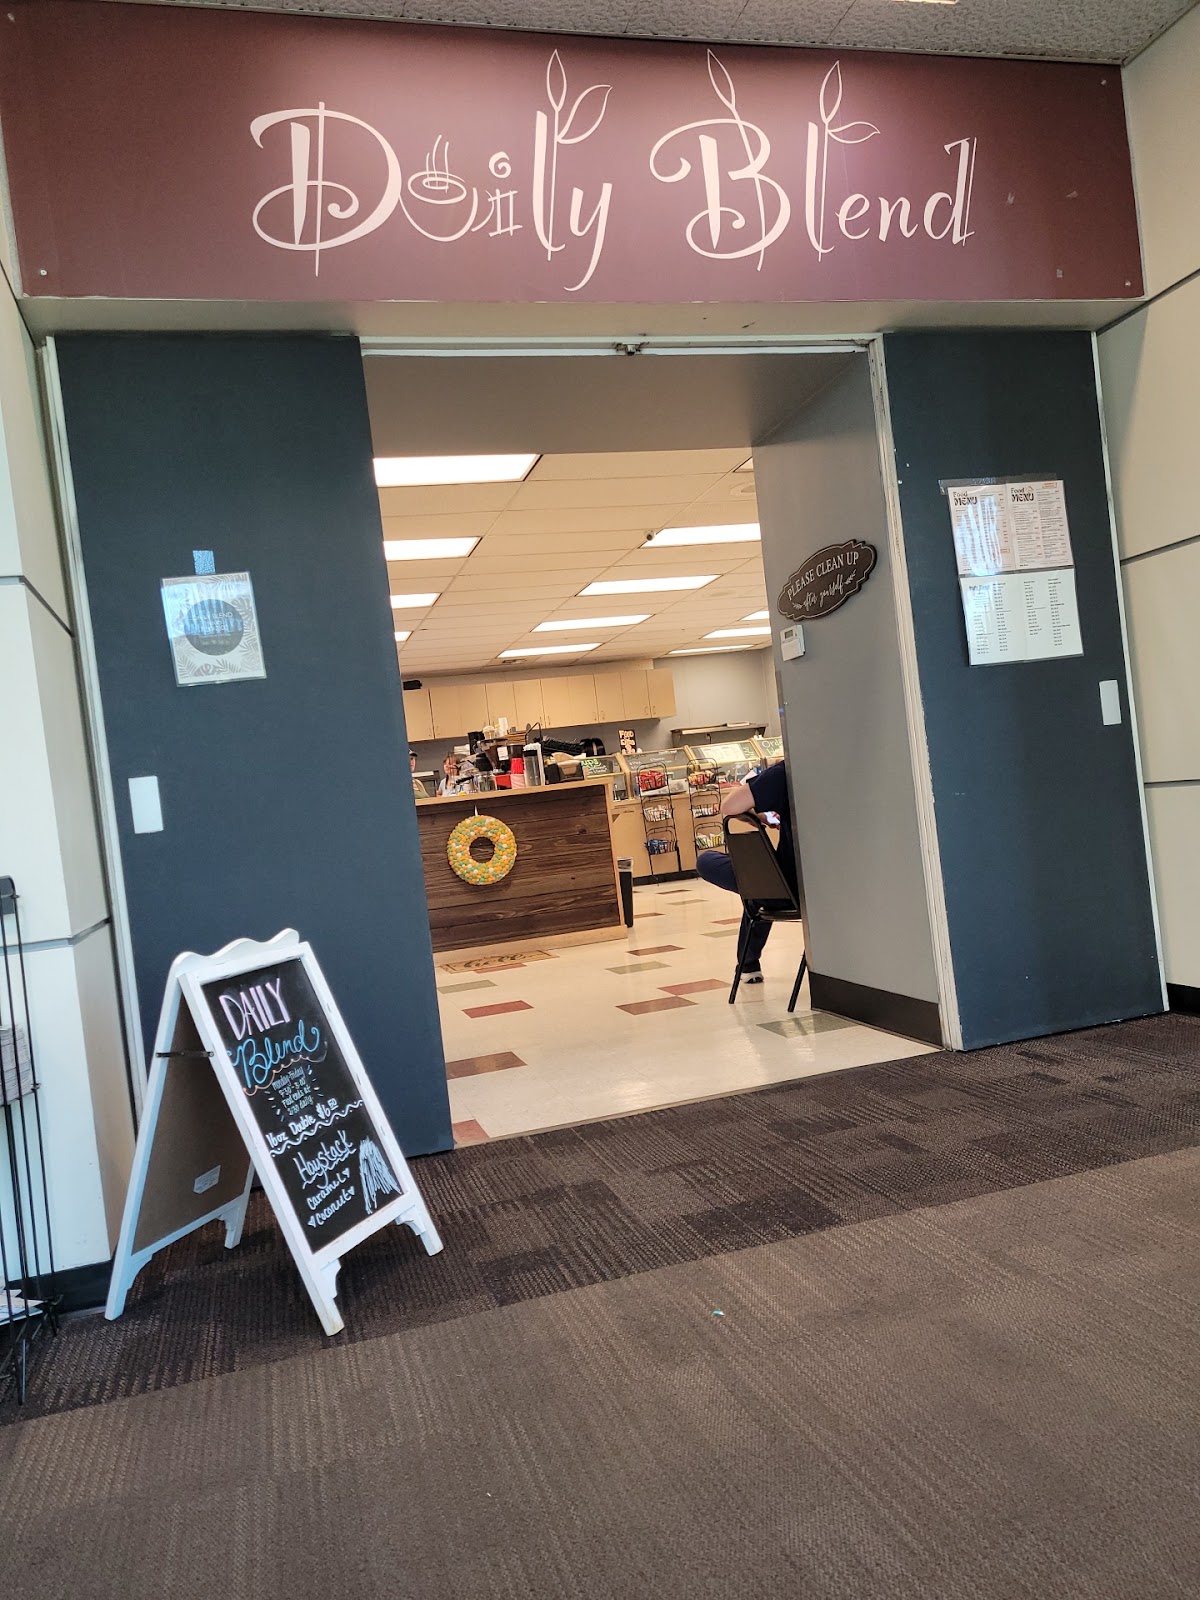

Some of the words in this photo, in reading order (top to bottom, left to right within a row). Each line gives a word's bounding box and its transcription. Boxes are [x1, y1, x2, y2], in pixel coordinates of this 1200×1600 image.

[250, 49, 612, 292] Daily
[649, 49, 978, 271] Blend
[954, 496, 978, 506] MENU
[1011, 493, 1034, 502] MENU
[787, 569, 815, 601] PLEASE
[816, 554, 844, 577] CLEAN
[846, 551, 860, 565] UP
[218, 977, 291, 1041] DAILY
[226, 1019, 321, 1089] Blend
[288, 1114, 316, 1135] Double
